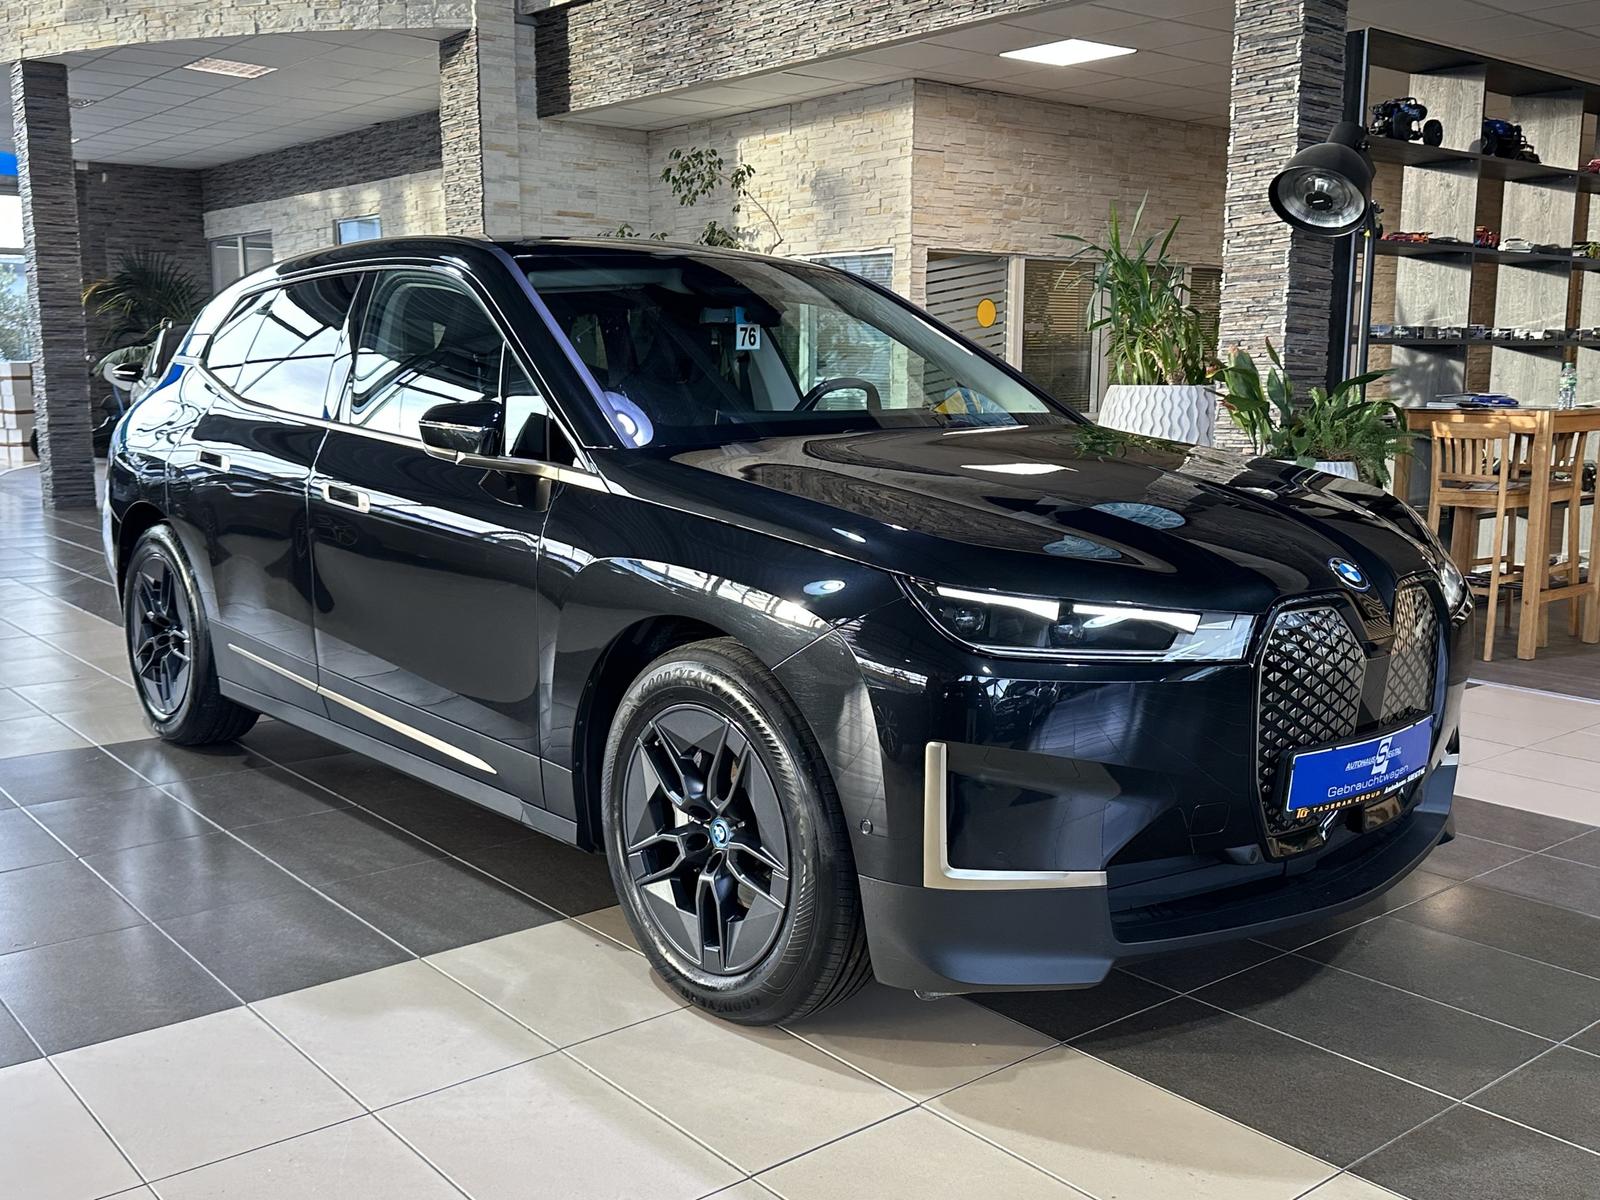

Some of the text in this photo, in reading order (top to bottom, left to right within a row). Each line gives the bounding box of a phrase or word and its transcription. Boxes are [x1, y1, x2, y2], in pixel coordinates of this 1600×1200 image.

[739, 327, 756, 347] 76
[1327, 764, 1409, 798] Gebrauchtwagen
[1355, 790, 1381, 803] GROUP
